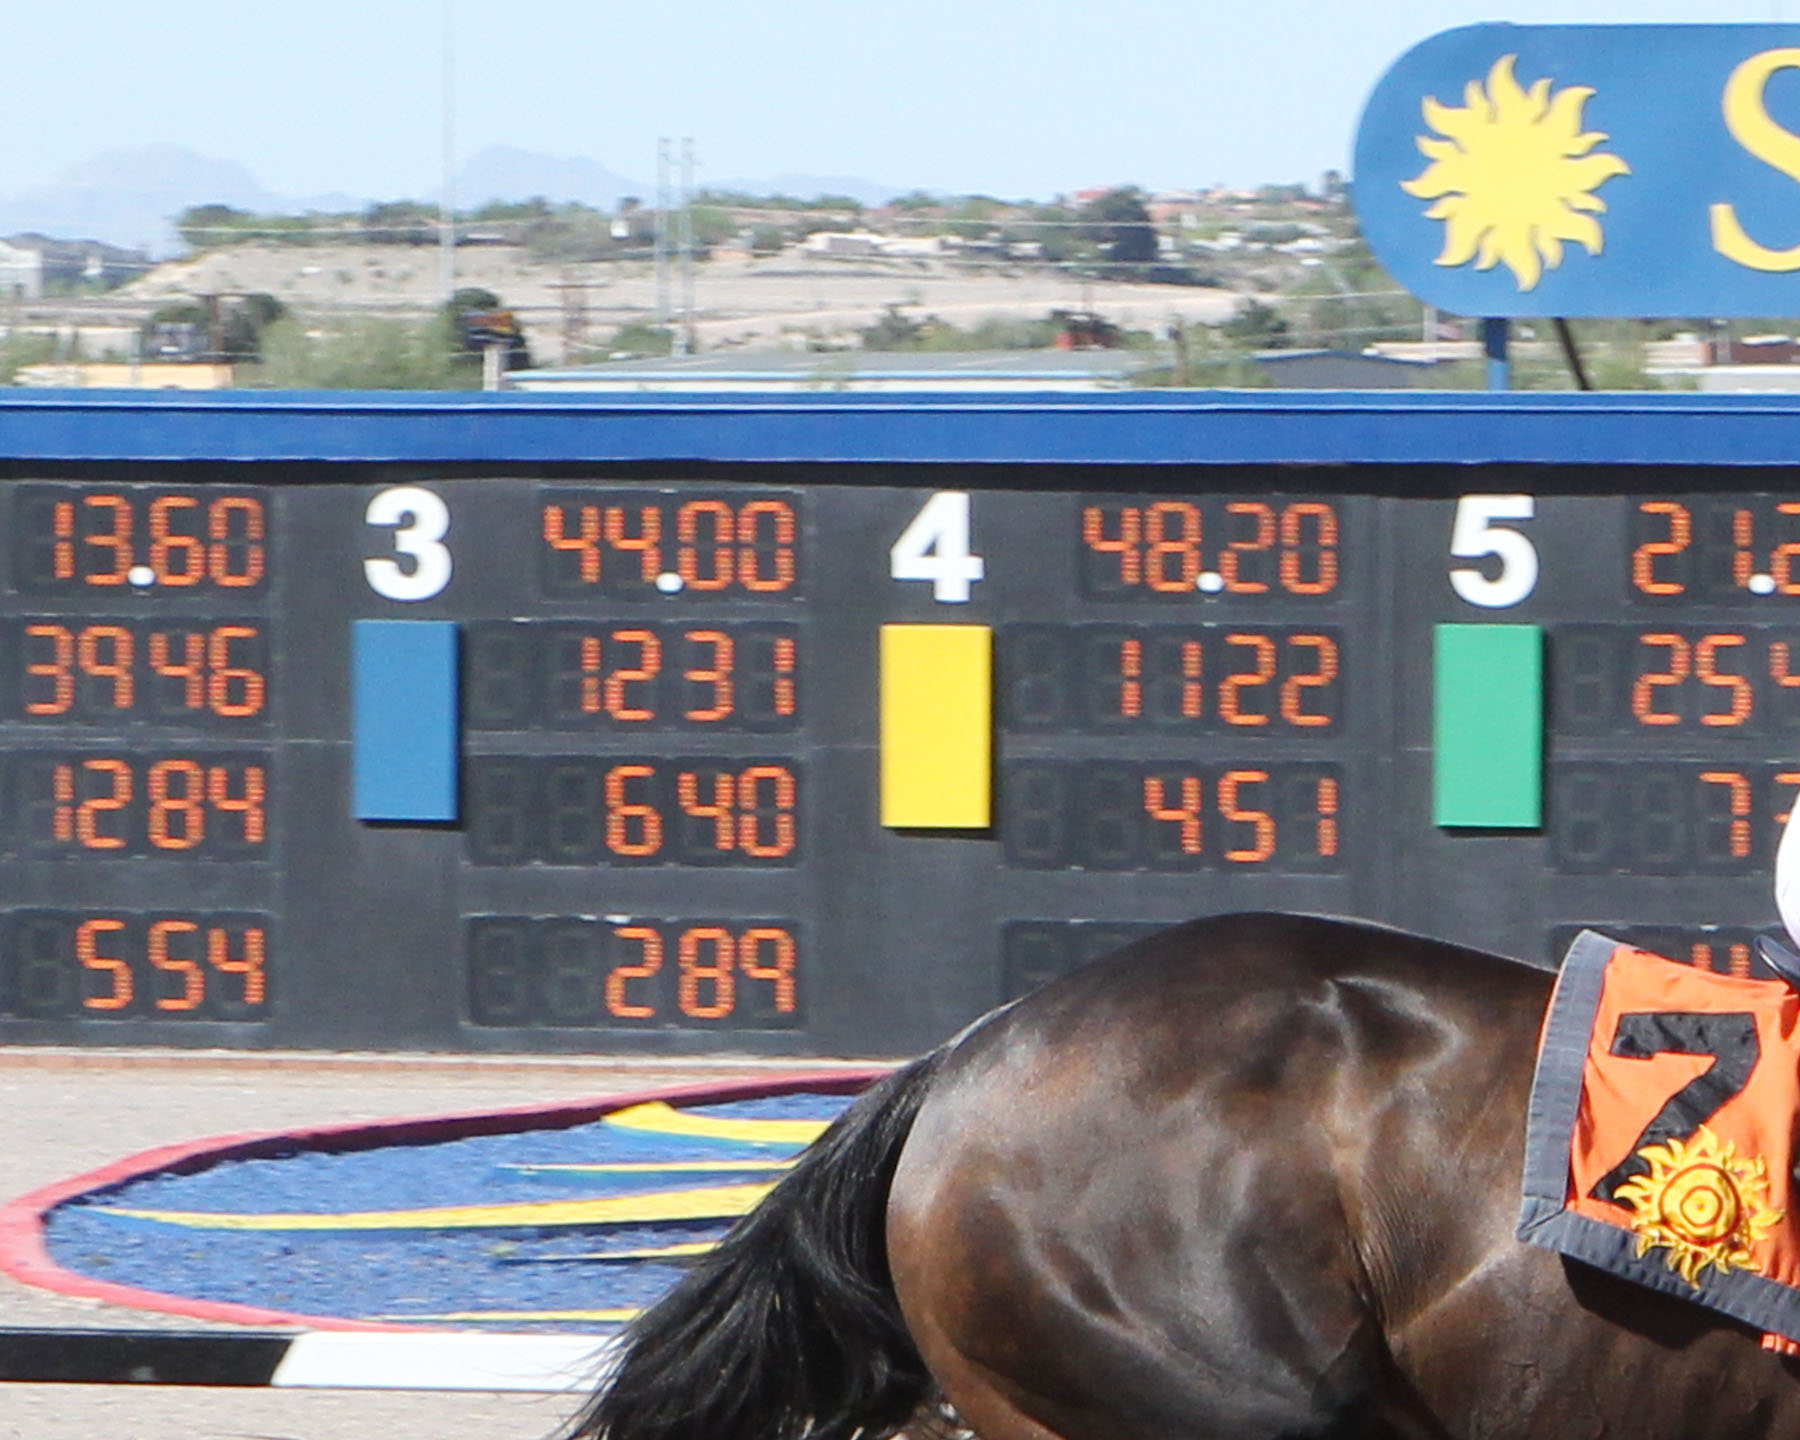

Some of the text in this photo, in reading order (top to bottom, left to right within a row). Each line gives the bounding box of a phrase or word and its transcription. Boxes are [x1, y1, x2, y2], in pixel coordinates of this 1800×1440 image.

[55, 495, 264, 588] 13.60
[365, 486, 451, 600] 3
[545, 501, 796, 592] 44.00
[891, 491, 984, 602] 4
[1084, 502, 1338, 595] 48.20
[1450, 495, 1538, 608] 5
[25, 626, 266, 717] 3946
[584, 630, 796, 722] 1231
[1122, 635, 1338, 727] 1122
[55, 760, 266, 850] 1284
[606, 766, 796, 858] 640
[1145, 771, 1338, 864] 451
[76, 920, 267, 1012] 554
[605, 927, 797, 1020] 289
[1590, 1010, 1760, 1206] 7
